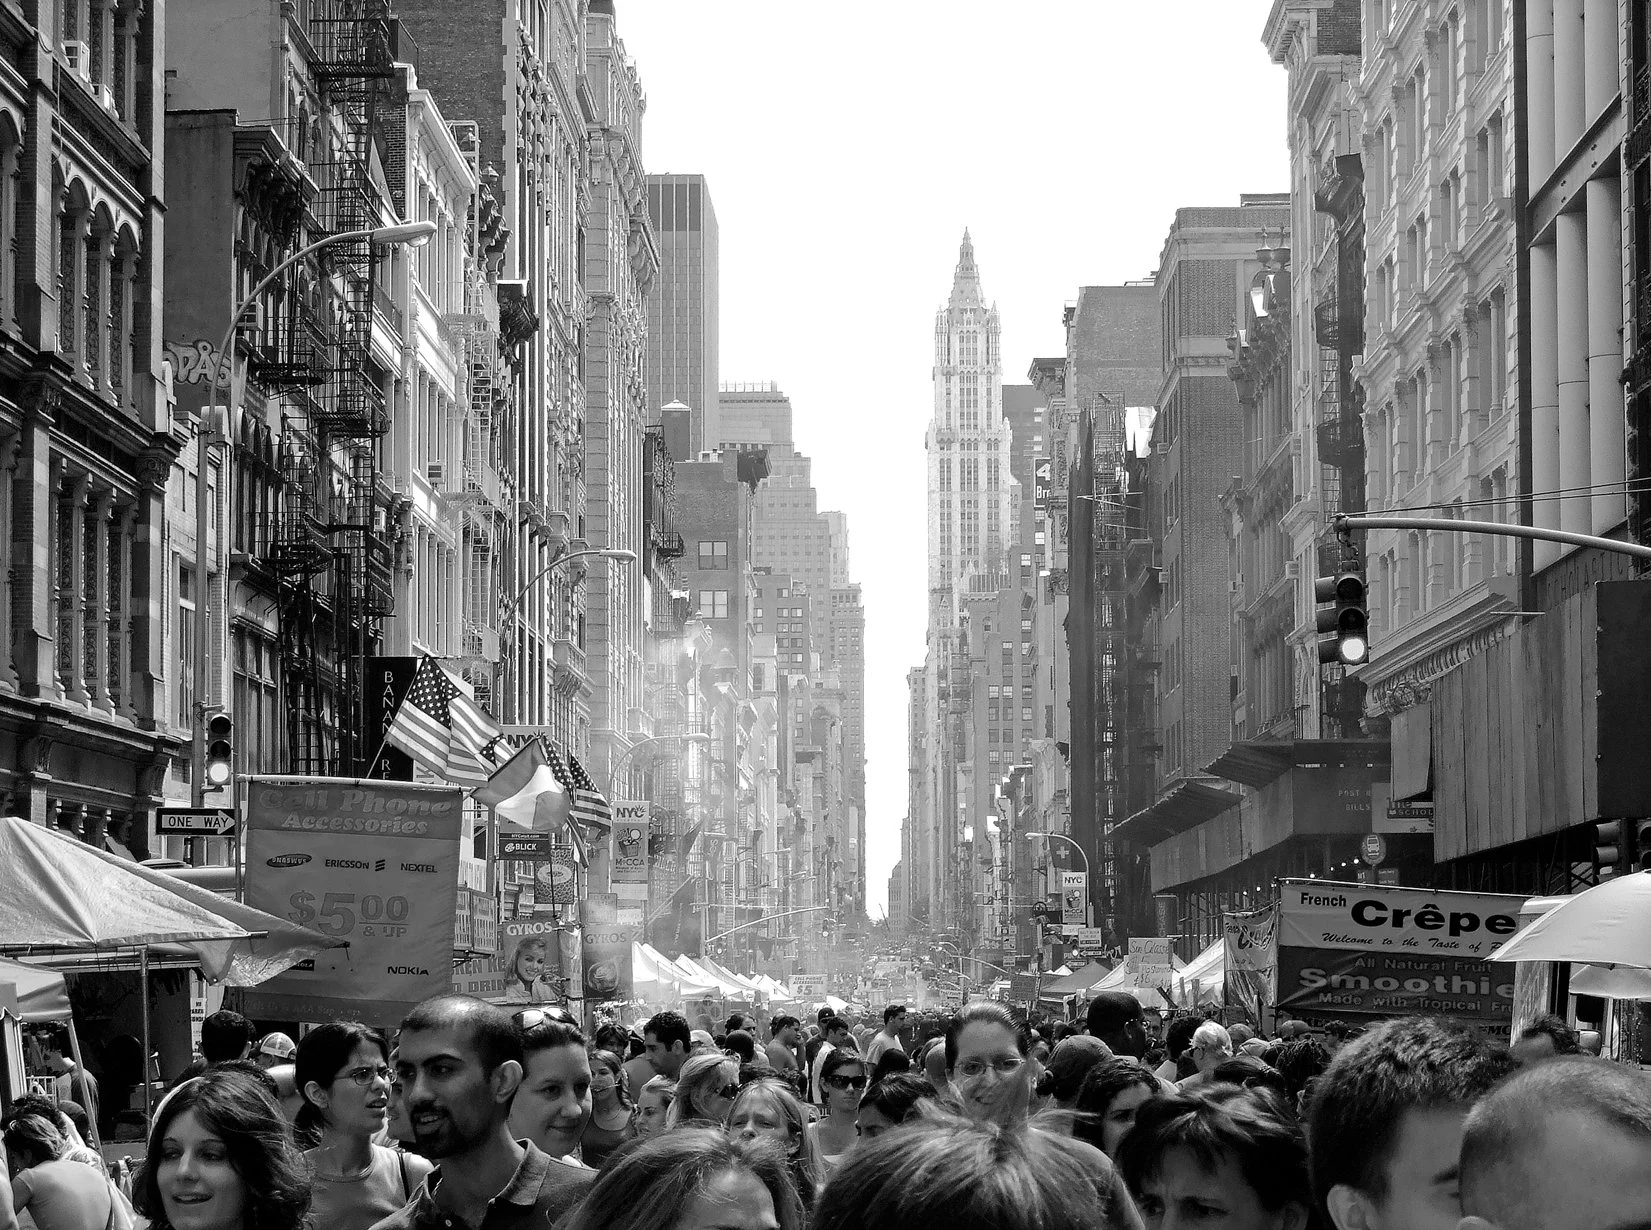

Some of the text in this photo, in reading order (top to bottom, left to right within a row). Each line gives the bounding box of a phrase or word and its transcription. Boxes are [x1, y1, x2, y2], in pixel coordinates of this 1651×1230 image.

[259, 789, 452, 817] Cell Phone
[616, 805, 645, 818] NYC
[168, 816, 229, 828] ONE WAY
[282, 812, 428, 834] Accessories
[515, 843, 537, 851] BLICK
[324, 859, 369, 870] ERICSSON
[400, 862, 438, 874] NEXTEL
[1300, 892, 1347, 907] French
[1351, 900, 1517, 937] Crêpe
[362, 926, 407, 938] & UP
[506, 921, 553, 936] GYROS
[585, 932, 627, 945] GYROS
[1321, 933, 1373, 946] Welcome
[1382, 937, 1393, 945] to
[1402, 937, 1419, 947] the
[1428, 938, 1460, 949] Taste
[1468, 941, 1482, 952] of
[387, 965, 429, 976] NOKIA
[1355, 958, 1493, 973] All Natural Fruit
[797, 985, 812, 995] $5
[1299, 968, 1514, 999] Smoothie
[1319, 992, 1363, 1006] Made
[1373, 995, 1407, 1007] with
[1418, 997, 1481, 1013] Tropical
